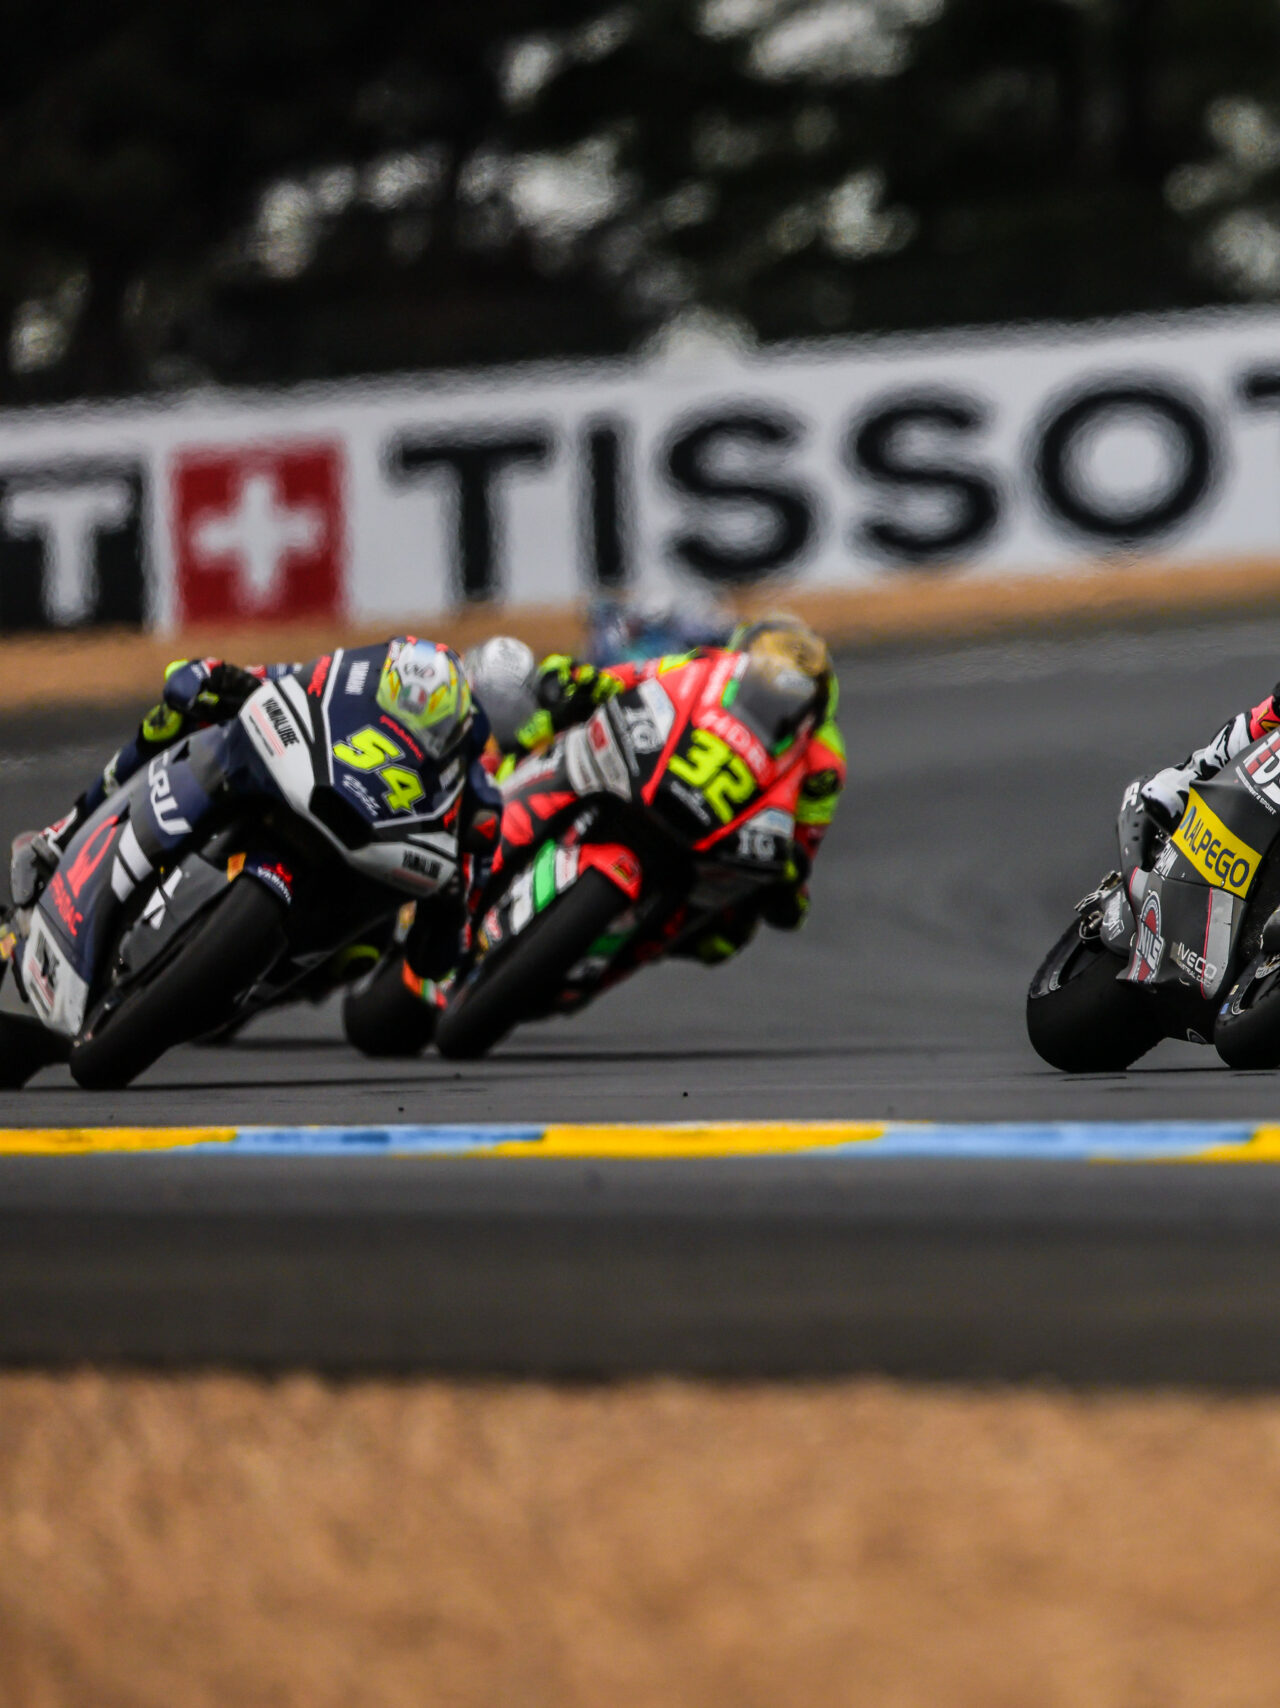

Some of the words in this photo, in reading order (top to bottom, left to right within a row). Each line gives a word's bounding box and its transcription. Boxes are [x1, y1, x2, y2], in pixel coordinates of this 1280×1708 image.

[333, 727, 425, 812] 54
[668, 728, 756, 824] 32
[1177, 942, 1217, 979] IVECO
